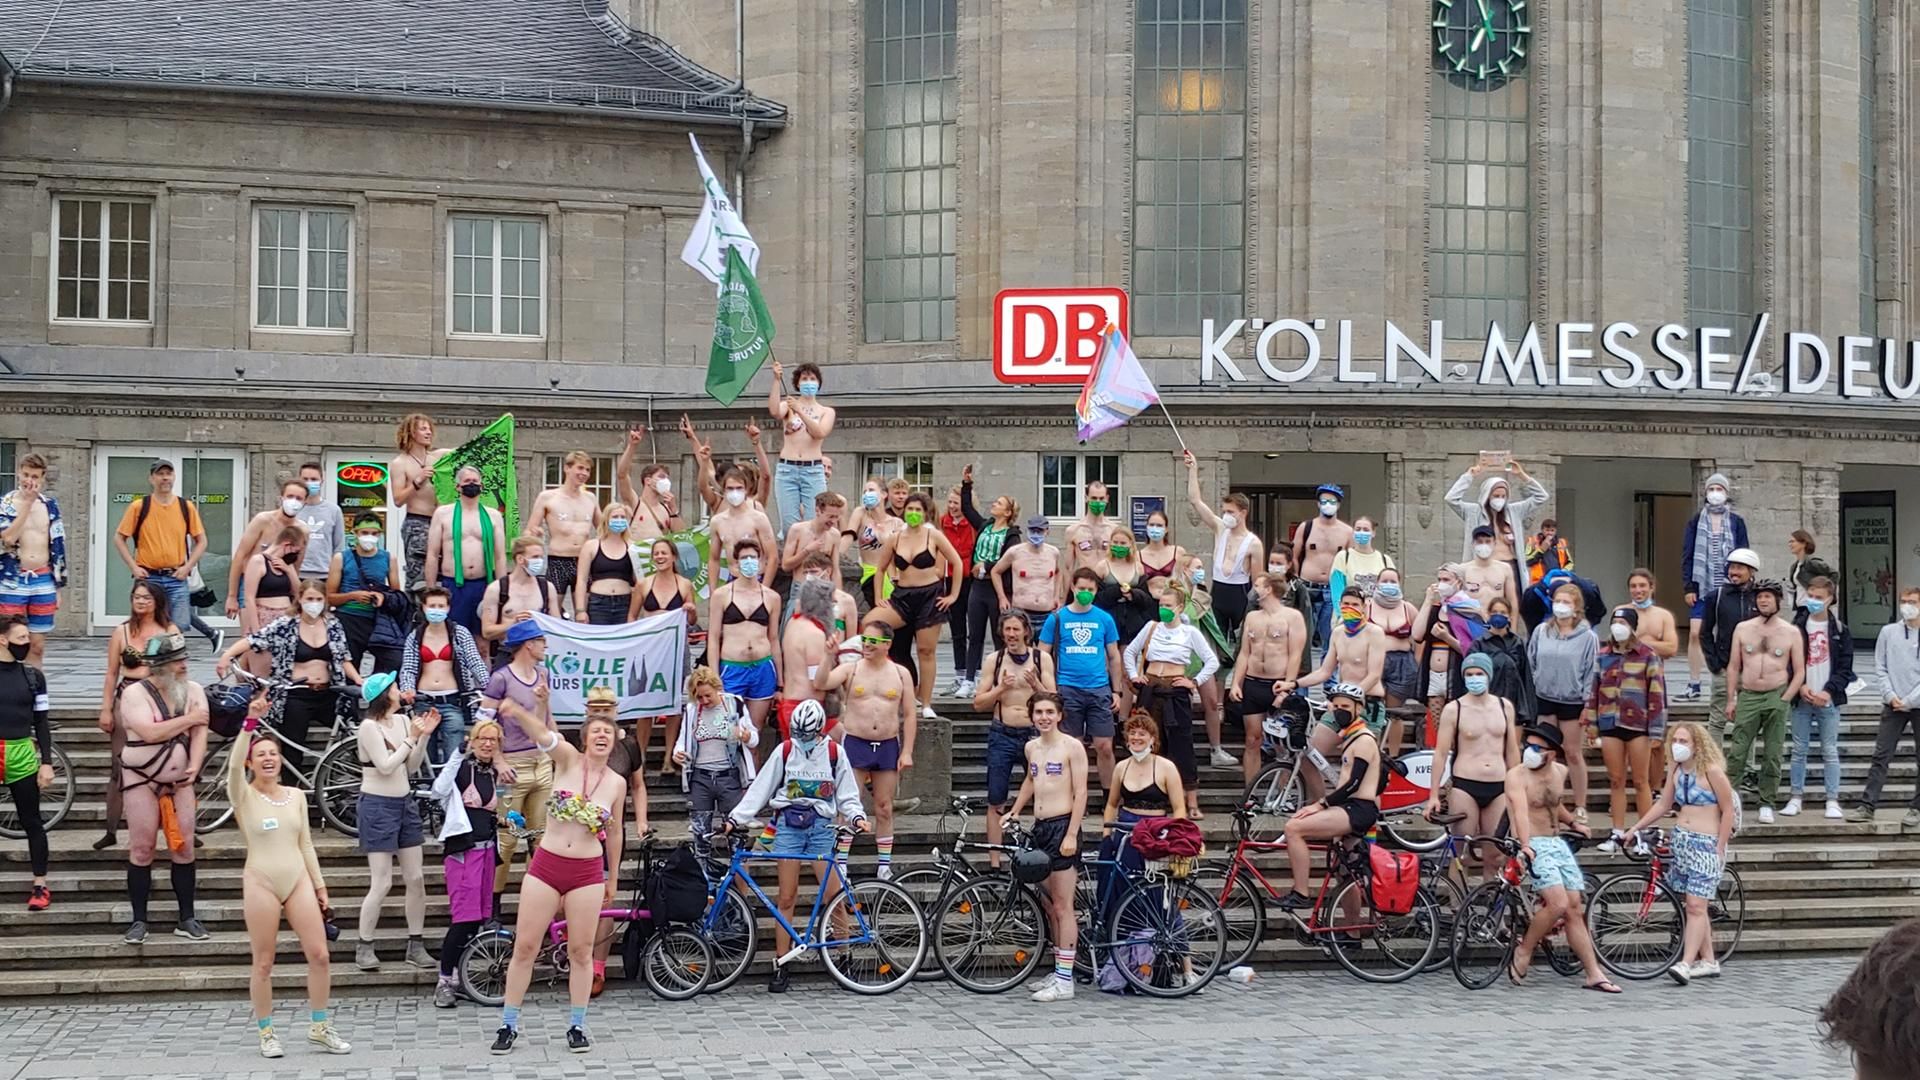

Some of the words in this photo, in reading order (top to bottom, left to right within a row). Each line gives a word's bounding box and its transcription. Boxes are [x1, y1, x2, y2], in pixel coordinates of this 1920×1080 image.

[1011, 303, 1108, 367] DB
[1201, 317, 1444, 384] KÖLN
[341, 466, 382, 483] OPEN
[341, 497, 384, 507] SUBWAY
[544, 651, 627, 676] KÖLLE
[546, 674, 580, 691] ÜRS
